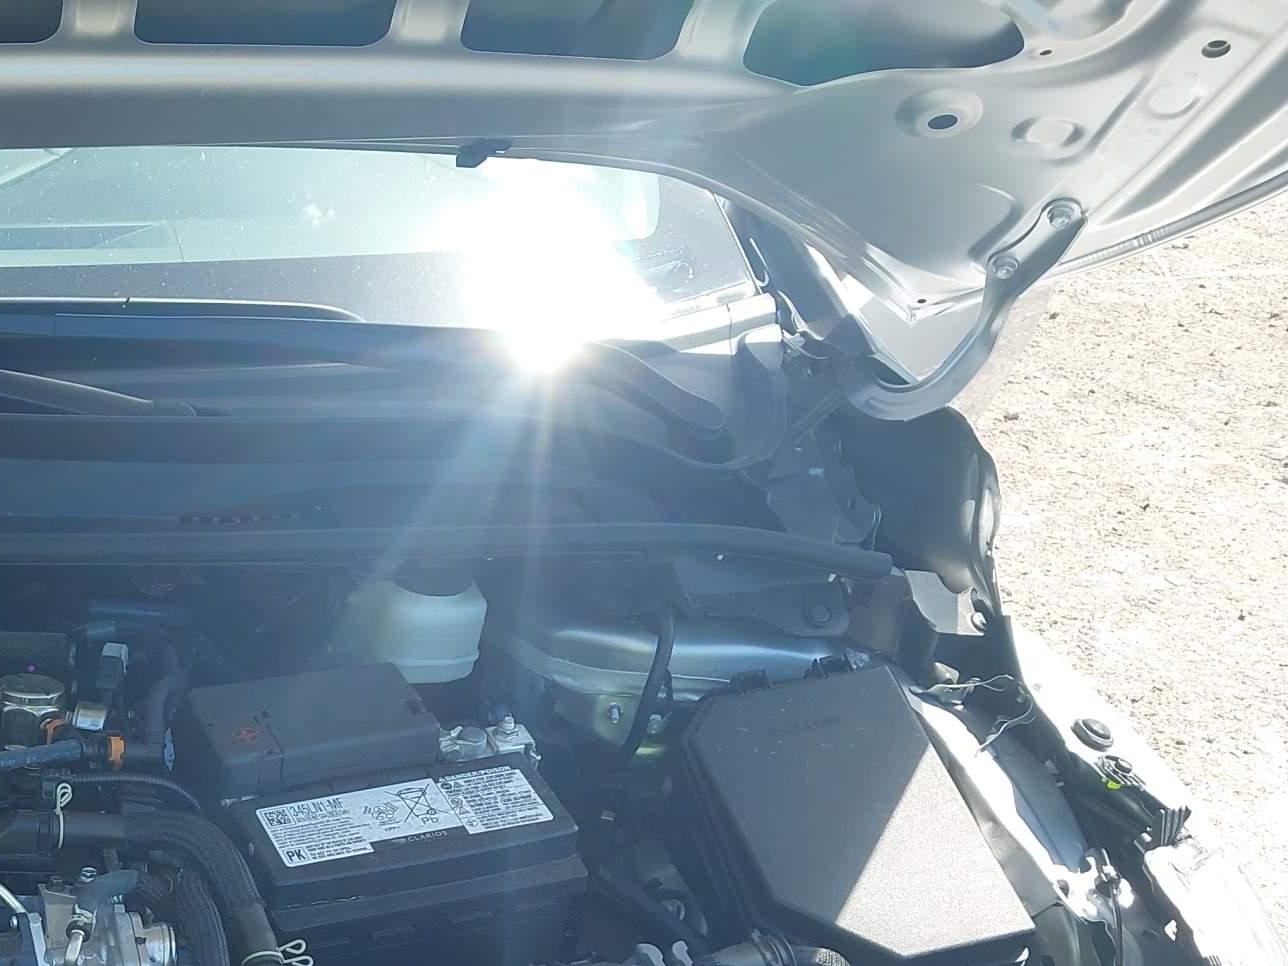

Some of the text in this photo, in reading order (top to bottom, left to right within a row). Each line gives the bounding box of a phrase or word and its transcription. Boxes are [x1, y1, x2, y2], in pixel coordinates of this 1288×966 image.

[289, 797, 344, 817] 345LN1-MF
[421, 817, 439, 825] Pb
[407, 830, 448, 842] CLARIOS
[285, 849, 306, 862] PK
